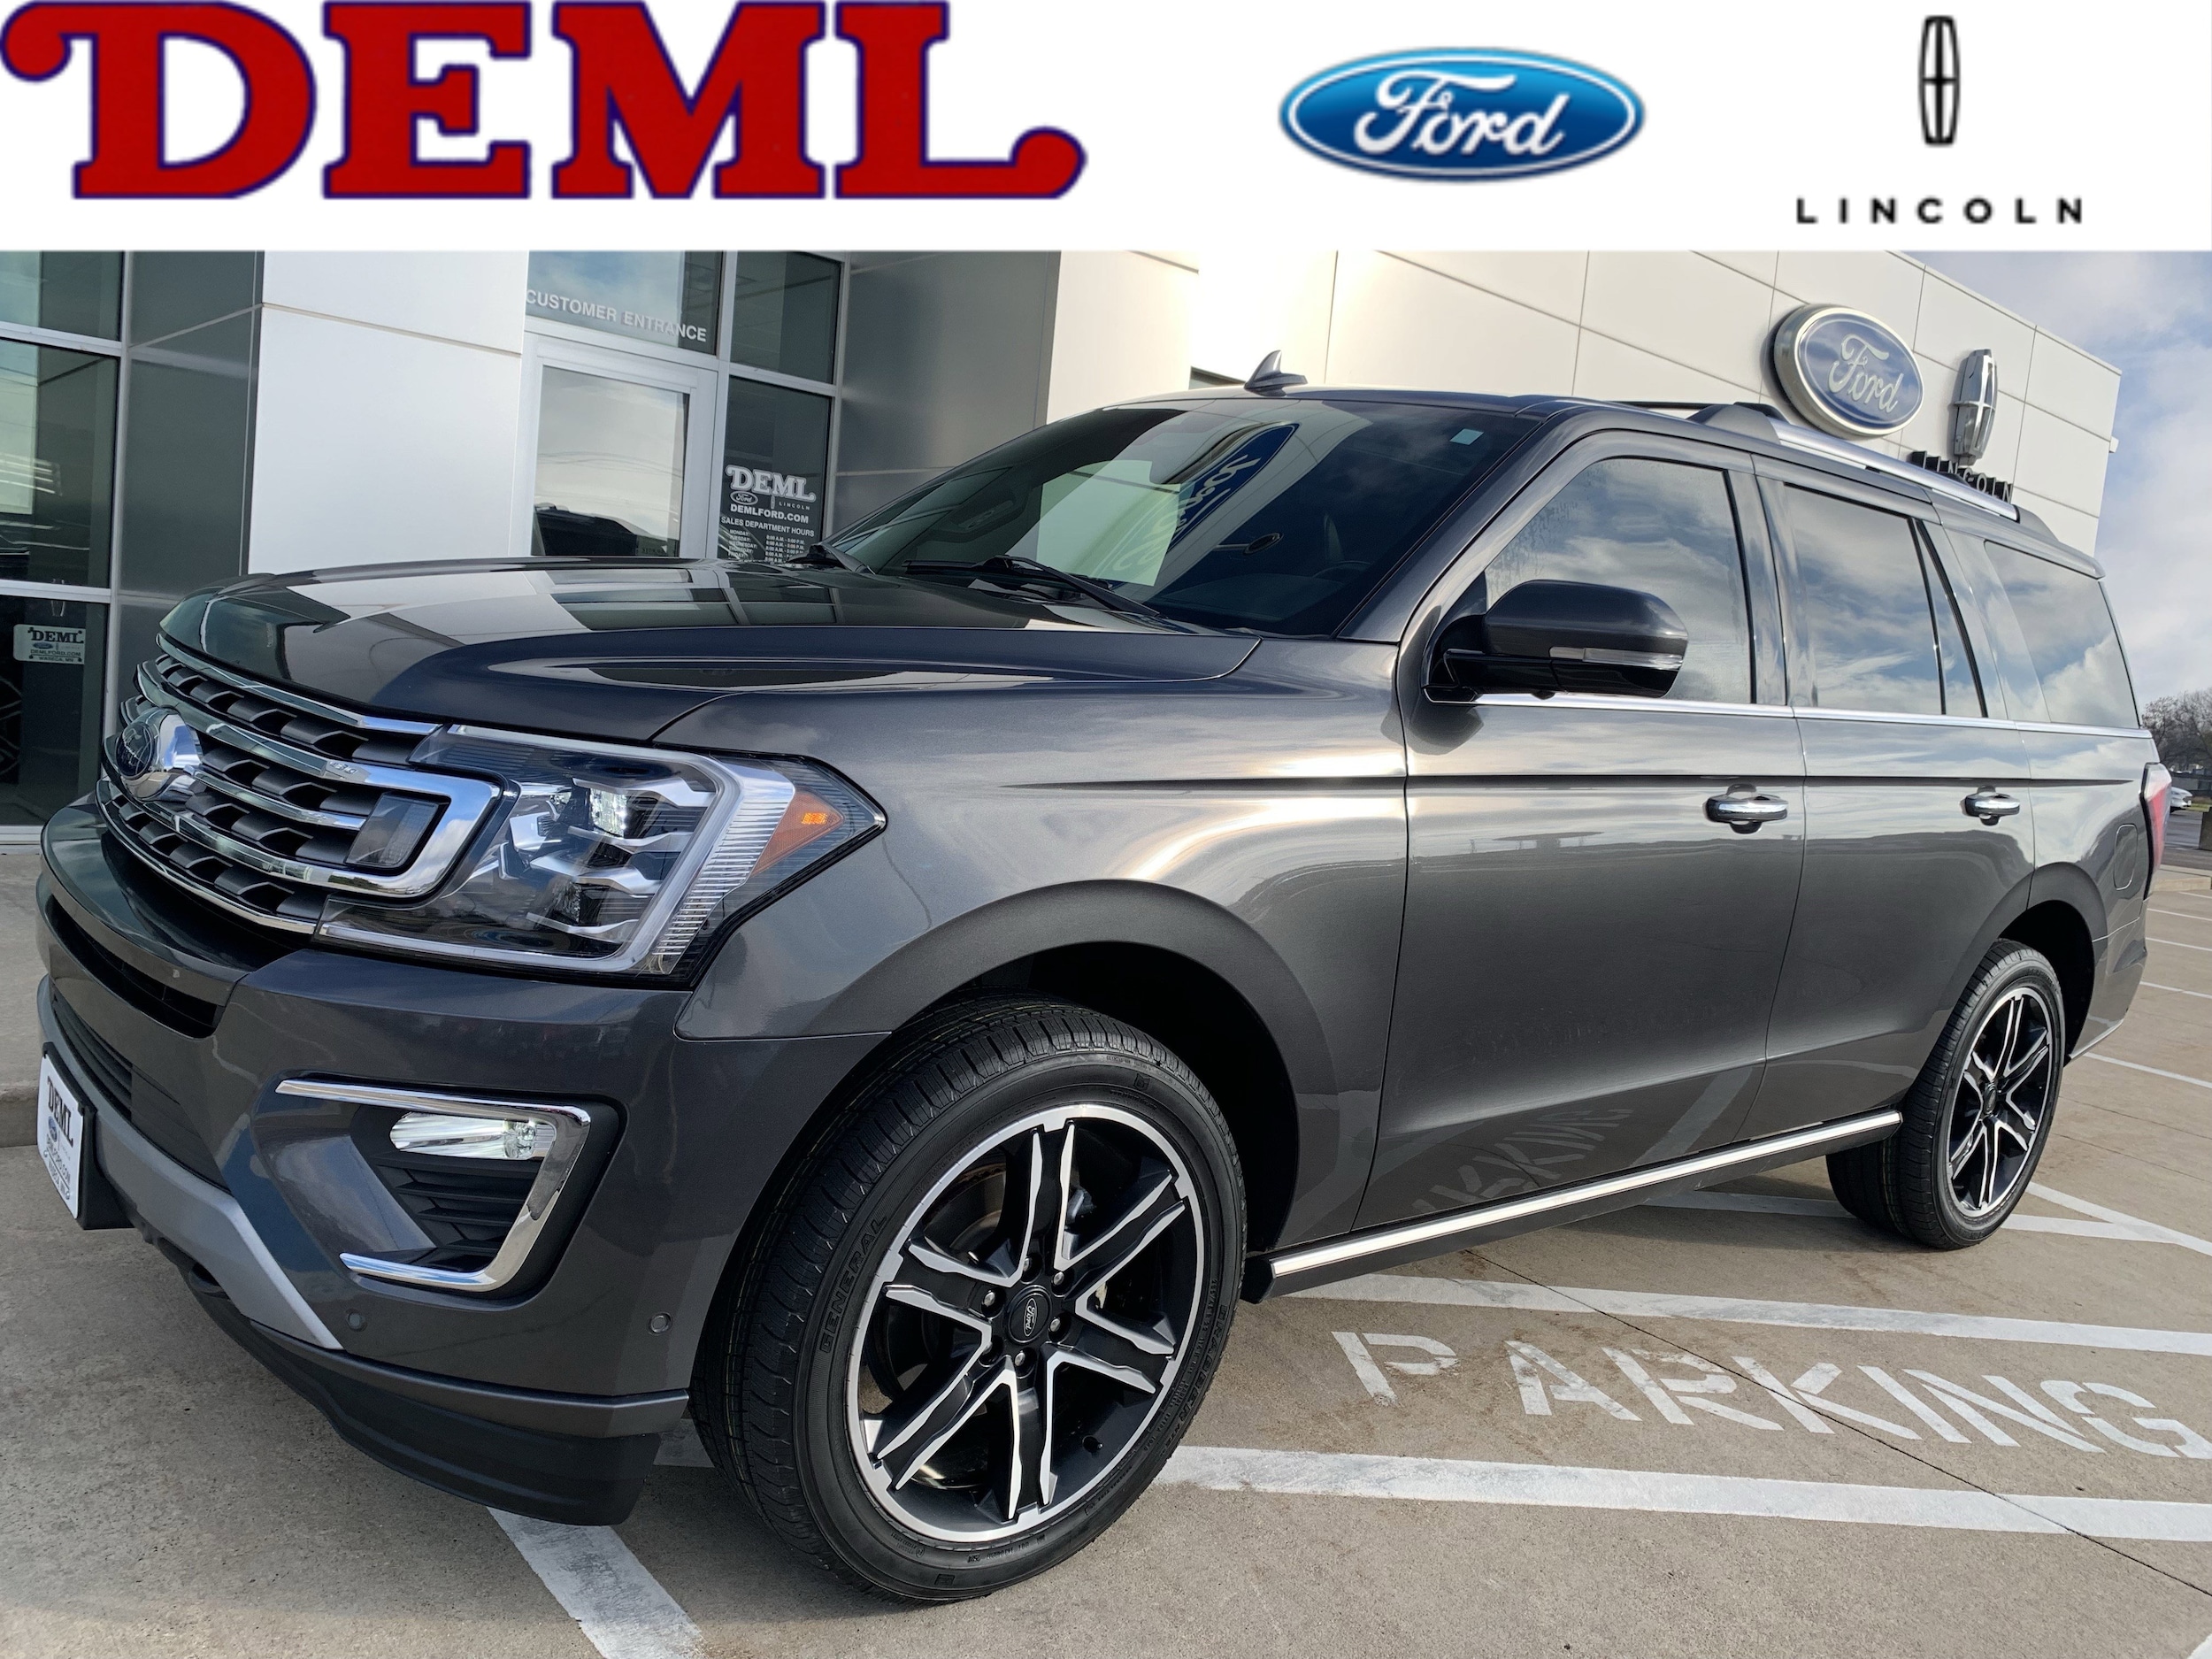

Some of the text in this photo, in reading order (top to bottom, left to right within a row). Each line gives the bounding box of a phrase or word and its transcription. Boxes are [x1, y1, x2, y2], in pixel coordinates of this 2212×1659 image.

[526, 289, 707, 342] CUSTOMER ENTRANCE
[1829, 334, 1904, 413] Ford
[726, 465, 816, 503] DEML
[730, 503, 809, 524] DEMLFORD.COM
[779, 501, 810, 511] LINCOLN
[721, 516, 815, 538] SALES DEPARTMENT HOURS
[27, 627, 84, 643] DEML
[819, 1216, 887, 1354] GENERAL
[1331, 1331, 2212, 1458] PARKING
